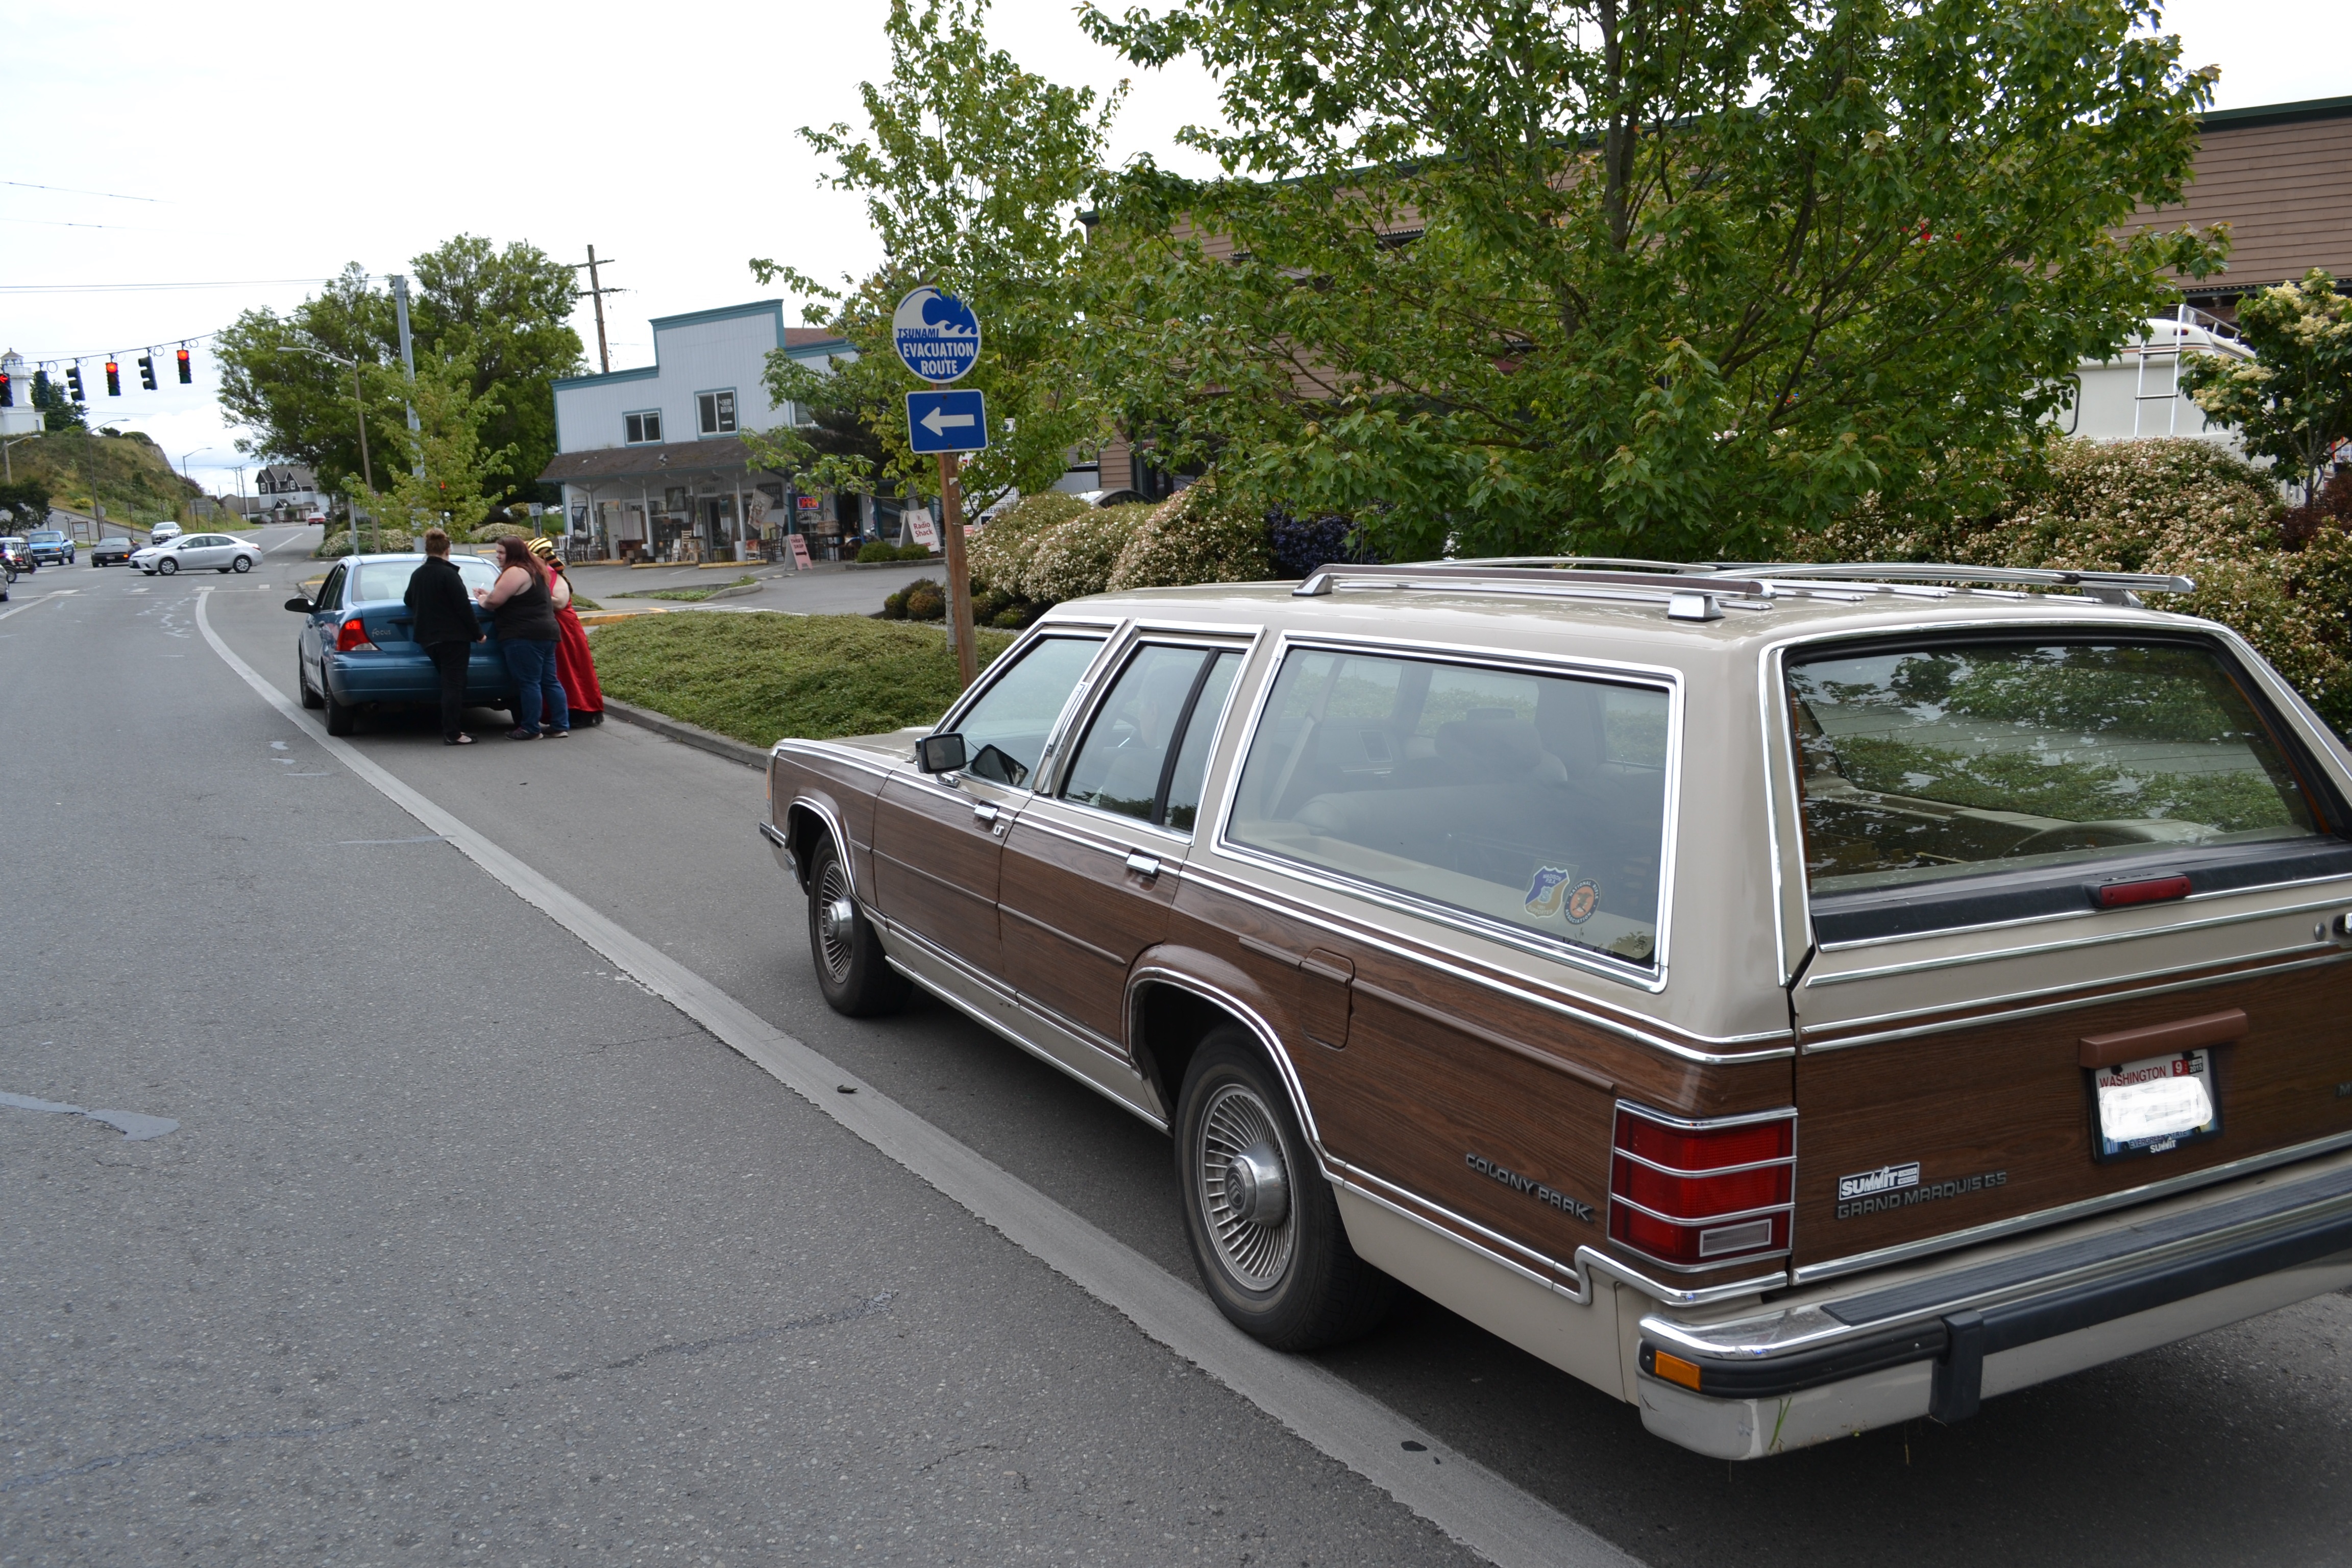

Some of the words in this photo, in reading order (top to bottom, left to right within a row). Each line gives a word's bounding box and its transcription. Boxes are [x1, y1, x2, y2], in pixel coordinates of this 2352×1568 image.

[897, 328, 939, 338] TSUNAMI
[903, 342, 974, 358] EVACUATION
[921, 360, 958, 375] ROUTE
[799, 497, 818, 508] OPEN
[913, 521, 930, 530] Radio
[915, 528, 933, 537] Shack
[1542, 873, 1562, 881] MADISON
[1569, 880, 1591, 897] NATIONAL
[1527, 905, 1553, 915] SUPPORTER
[1565, 909, 1591, 924] ASSOCIATION
[2175, 1061, 2183, 1073] 9
[2189, 1065, 2203, 1073] 2015
[2099, 1065, 2167, 1088] WASHINGTON
[2129, 1134, 2165, 1148] EVERGREEN
[1465, 1152, 1535, 1196] COLONY
[1538, 1185, 1595, 1223] PARK
[1837, 1193, 1900, 1219] GRAND
[1904, 1176, 1982, 1205] MARQUIS
